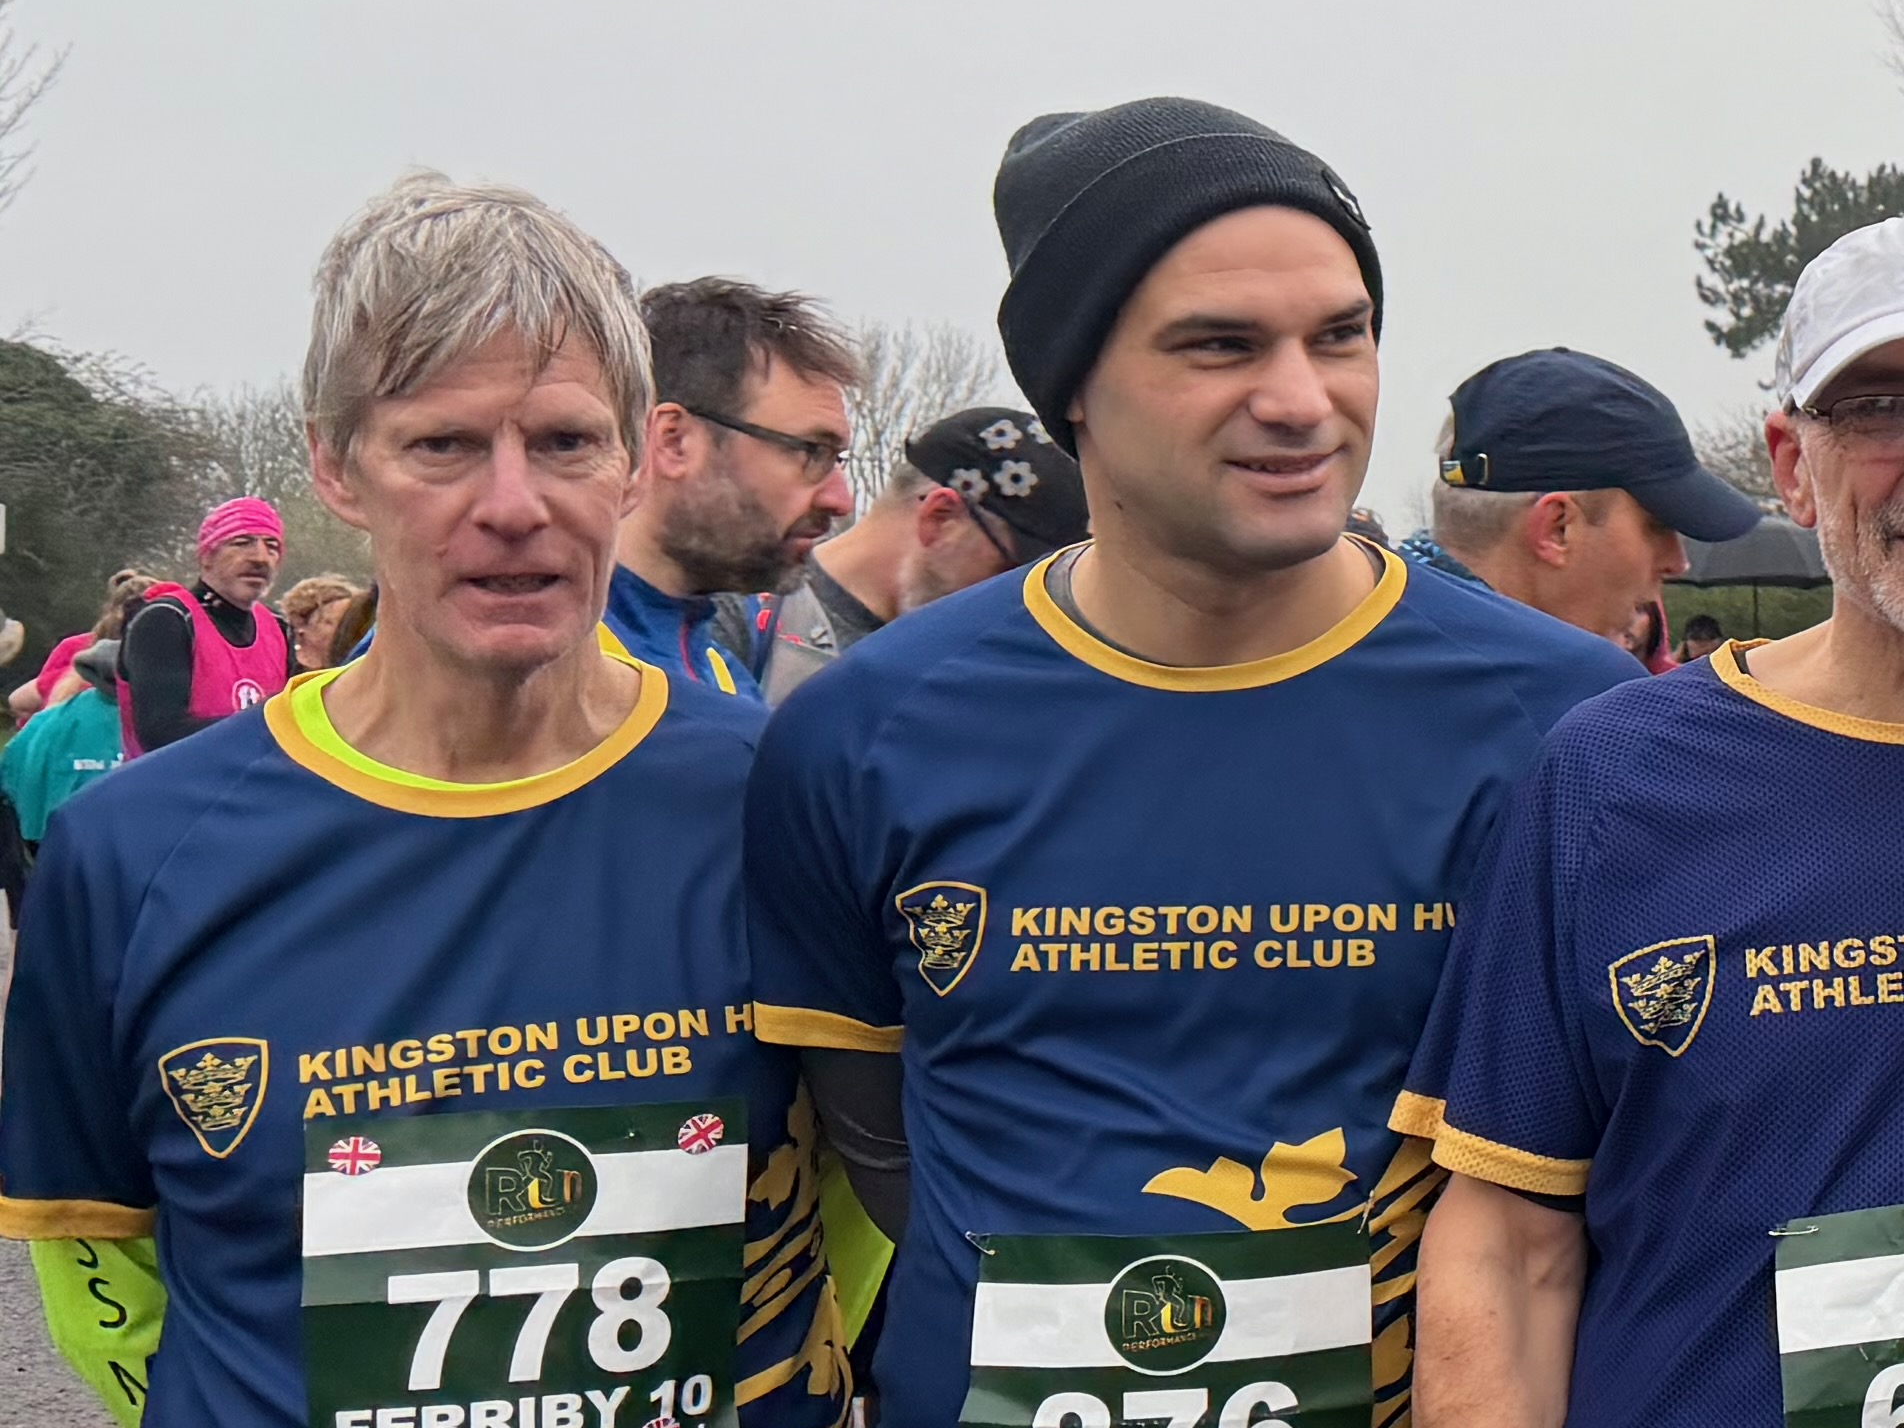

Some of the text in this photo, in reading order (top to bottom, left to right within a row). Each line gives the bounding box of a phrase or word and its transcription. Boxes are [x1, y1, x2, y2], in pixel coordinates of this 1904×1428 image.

[1012, 904, 1253, 936] KINGSTON
[1269, 903, 1396, 932] UPON
[1010, 939, 1375, 971] ATHLETIC CLUB
[299, 1022, 559, 1083] KINGSTON
[577, 1007, 709, 1048] UPON
[304, 1046, 693, 1118] ATHLETIC CLUB
[388, 1257, 672, 1391] 778
[650, 1374, 713, 1422] 10
